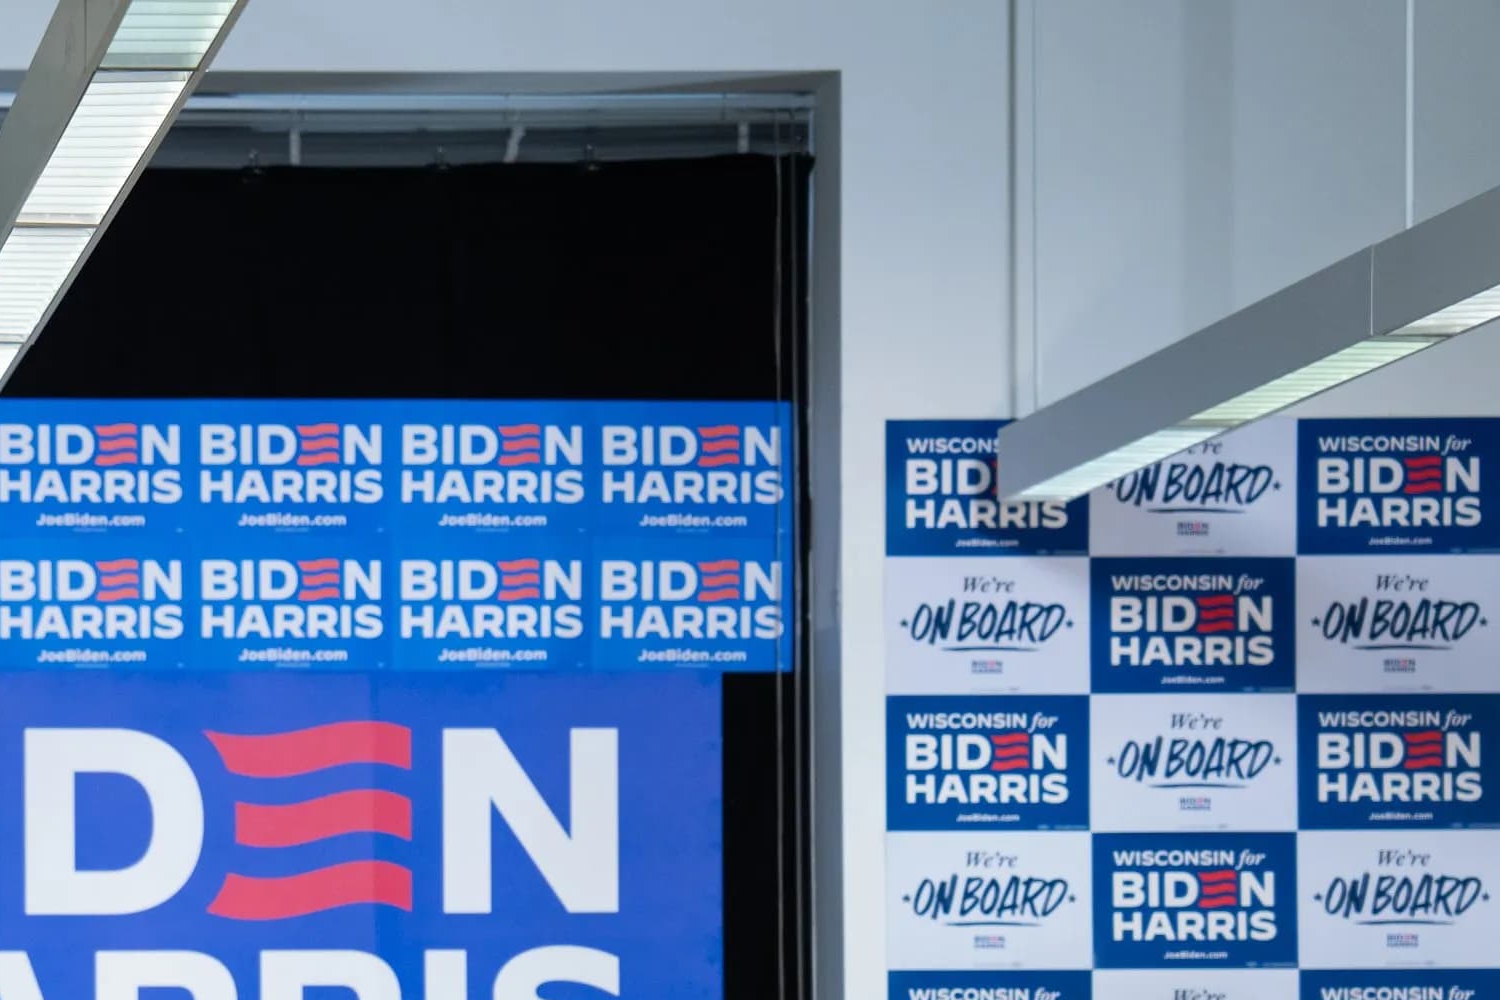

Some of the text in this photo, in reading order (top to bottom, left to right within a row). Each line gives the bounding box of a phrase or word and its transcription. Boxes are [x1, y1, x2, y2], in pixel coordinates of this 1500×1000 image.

[200, 423, 382, 466] BIDEN
[402, 423, 582, 466] BIDEN
[602, 425, 781, 467] BIDEN
[1318, 435, 1471, 456] WISCONSIN for
[200, 469, 383, 503] HARRIS
[401, 470, 584, 503] HARRIS
[603, 471, 784, 504] HARRIS
[1318, 456, 1479, 494] BIDEN
[36, 513, 145, 526] JoeBiden.com
[238, 512, 346, 526] JoeBiden.com
[438, 513, 547, 526] JoeBiden.com
[639, 514, 747, 526] JoeBiden.com
[906, 500, 1069, 528] HARRIS
[1318, 496, 1481, 527] HARRIS
[201, 559, 381, 601] BIDEN
[401, 559, 581, 602] BIDEN
[601, 559, 781, 602] BIDEN
[964, 577, 1015, 593] We're
[1112, 574, 1264, 595] WISCONSIN for
[1376, 575, 1428, 591] We're
[0, 605, 183, 639] HARRIS
[201, 605, 383, 638] HARRIS
[401, 605, 582, 638] HARRIS
[601, 606, 783, 639] HARRIS
[1110, 595, 1272, 633] BIDEN
[37, 649, 146, 662] JoeBiden.com
[239, 648, 348, 661] JoeBiden.com
[438, 647, 547, 661] JoeBiden.com
[638, 648, 746, 662] JoeBiden.com
[1111, 636, 1273, 666] HARRIS
[907, 712, 1058, 733] WISCONSIN for
[1171, 713, 1223, 730] We're
[1318, 710, 1472, 731] WISCONSIN for
[906, 733, 1066, 771] BIDEN
[1318, 731, 1480, 770] BIDEN
[906, 773, 1068, 803] HARRIS
[1318, 772, 1482, 802] HARRIS
[967, 851, 1018, 868] We're
[1113, 849, 1265, 870] WISCONSIN for
[1378, 849, 1430, 866] We're
[1113, 870, 1274, 908] BIDEN
[1113, 910, 1277, 941] HARRIS
